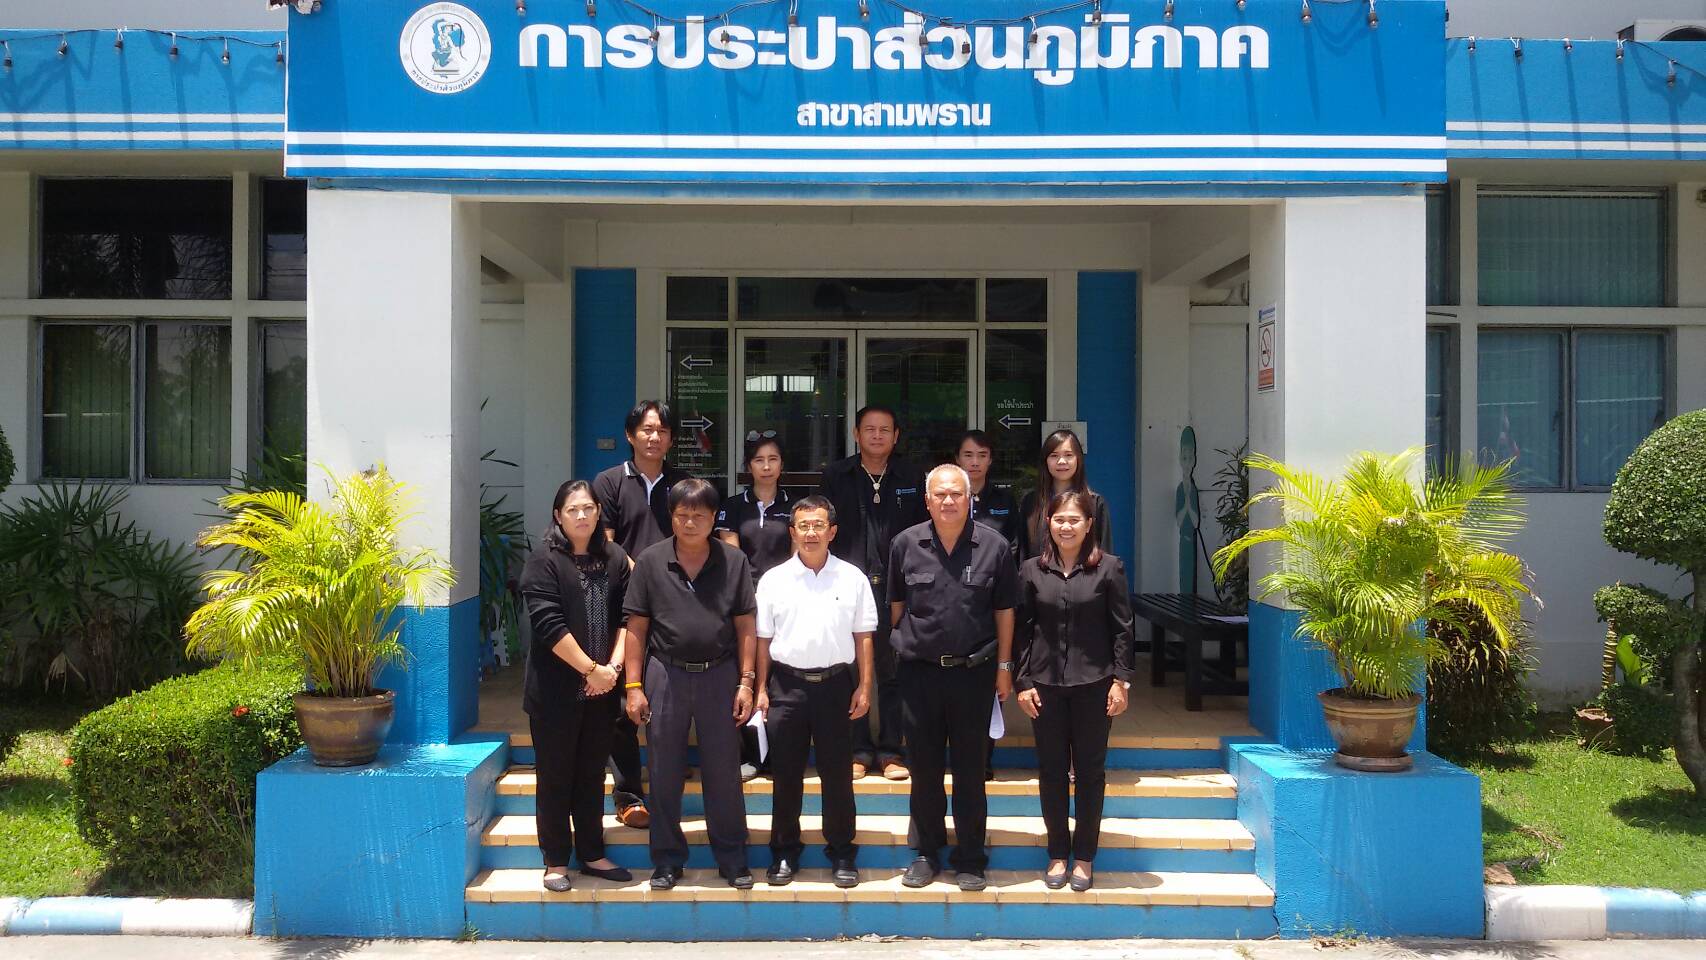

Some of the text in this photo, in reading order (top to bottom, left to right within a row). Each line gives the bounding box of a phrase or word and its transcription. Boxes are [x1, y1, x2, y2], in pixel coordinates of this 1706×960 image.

[518, 12, 1270, 86] การประปาส่วนภูมิภาค
[797, 101, 991, 126] สาขาสามพราน
